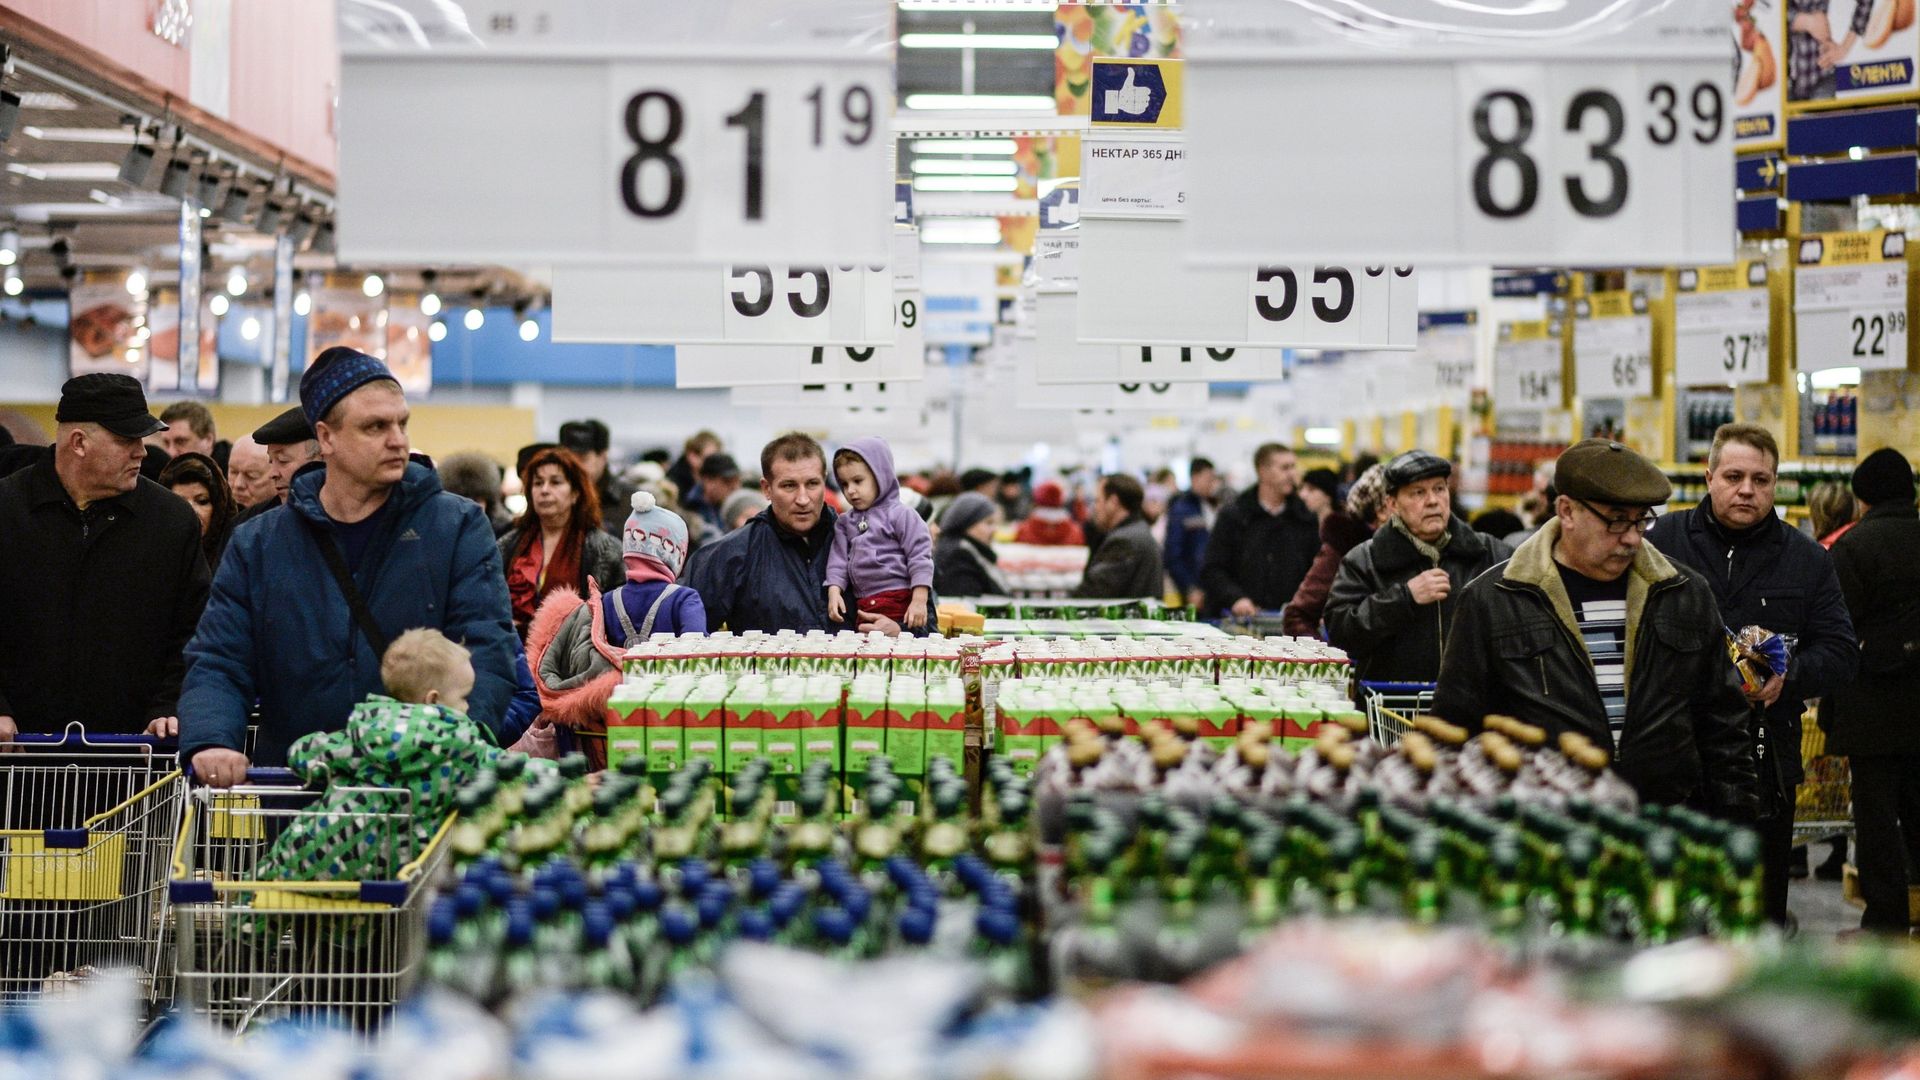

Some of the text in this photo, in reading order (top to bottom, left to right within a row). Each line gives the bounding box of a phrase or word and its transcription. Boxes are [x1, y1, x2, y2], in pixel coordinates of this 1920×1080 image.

[1858, 62, 1907, 84] ЛЕНТА
[621, 85, 874, 220] 81 19
[1092, 148, 1139, 159] НЕКТАР
[1142, 150, 1162, 159] 365
[1473, 82, 1722, 218] 83 39
[1724, 335, 1751, 371] 37
[1852, 312, 1905, 356] 22 99
